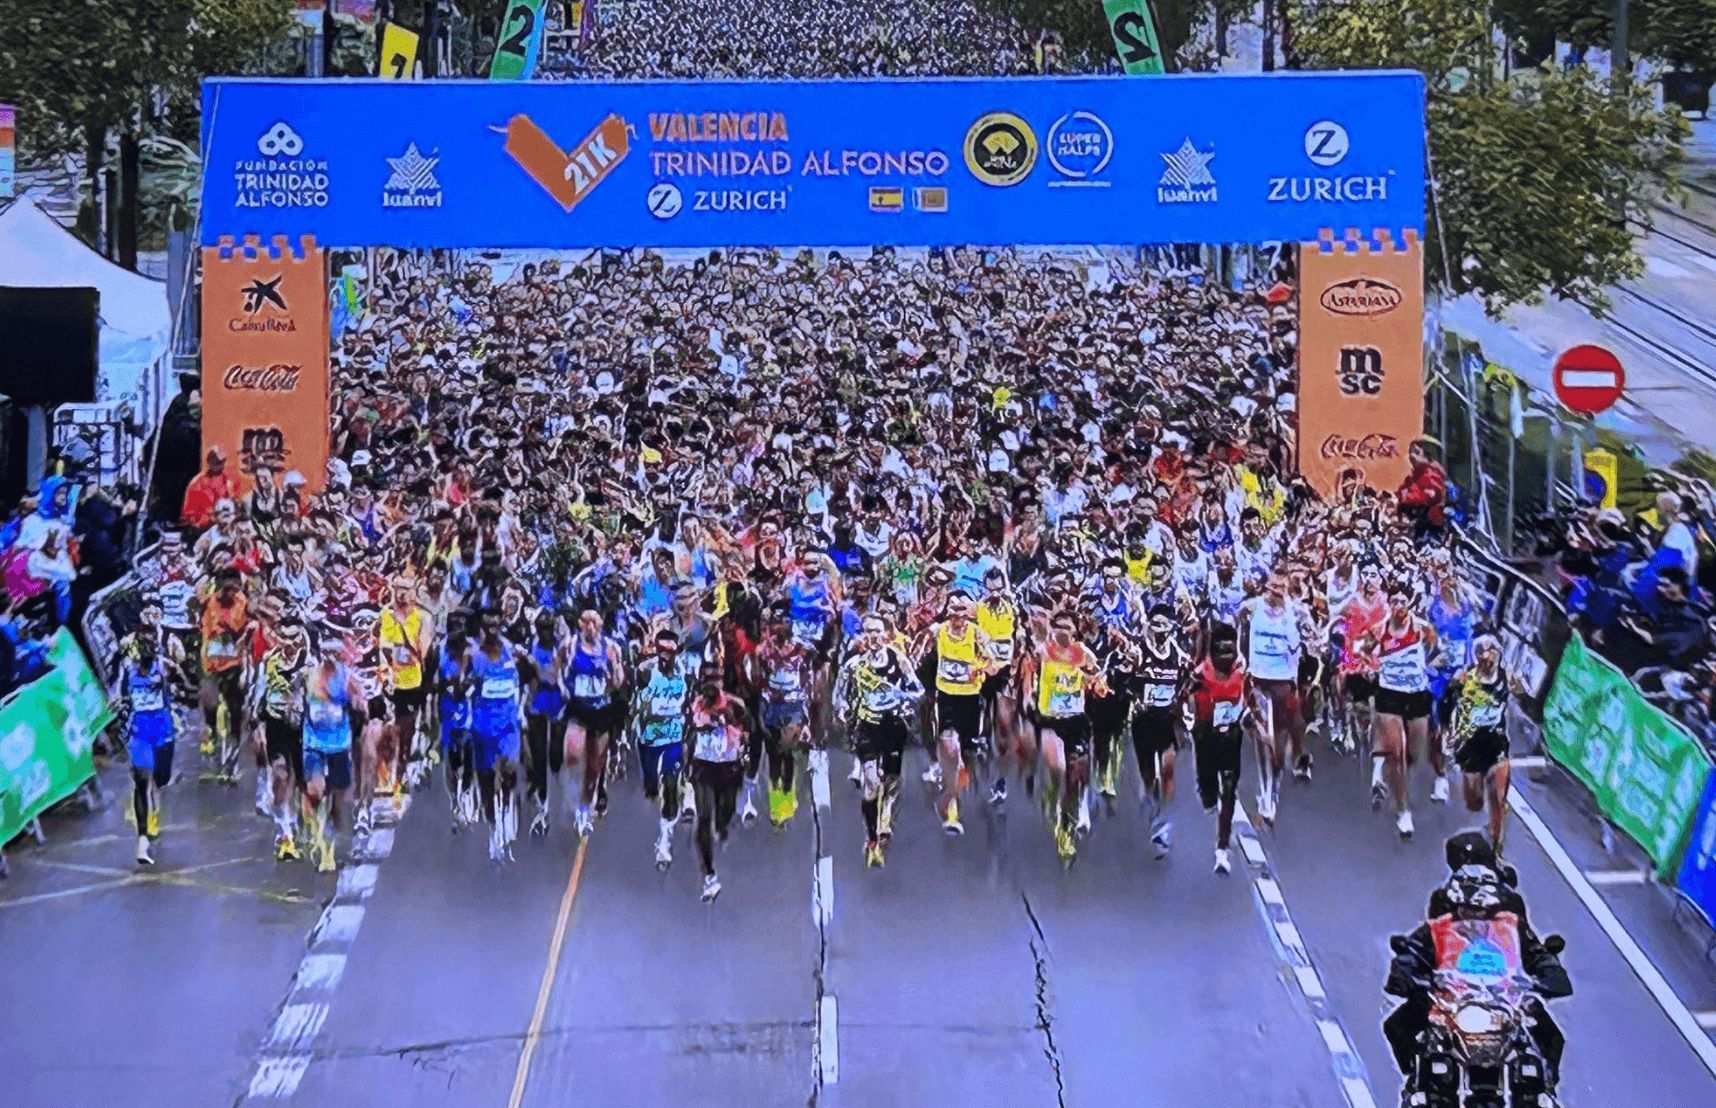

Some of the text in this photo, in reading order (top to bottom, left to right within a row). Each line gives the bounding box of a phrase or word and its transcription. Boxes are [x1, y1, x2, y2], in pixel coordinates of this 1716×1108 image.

[500, 5, 534, 56] 2
[648, 112, 789, 142] VALENCIA
[564, 131, 617, 196] 21K
[650, 150, 949, 177] TRINIDAD ALFONSO
[234, 173, 329, 191] TRINIDAD
[1267, 176, 1387, 202] ZURICH
[234, 191, 329, 208] ALFONSO
[692, 190, 787, 211] ZURICH
